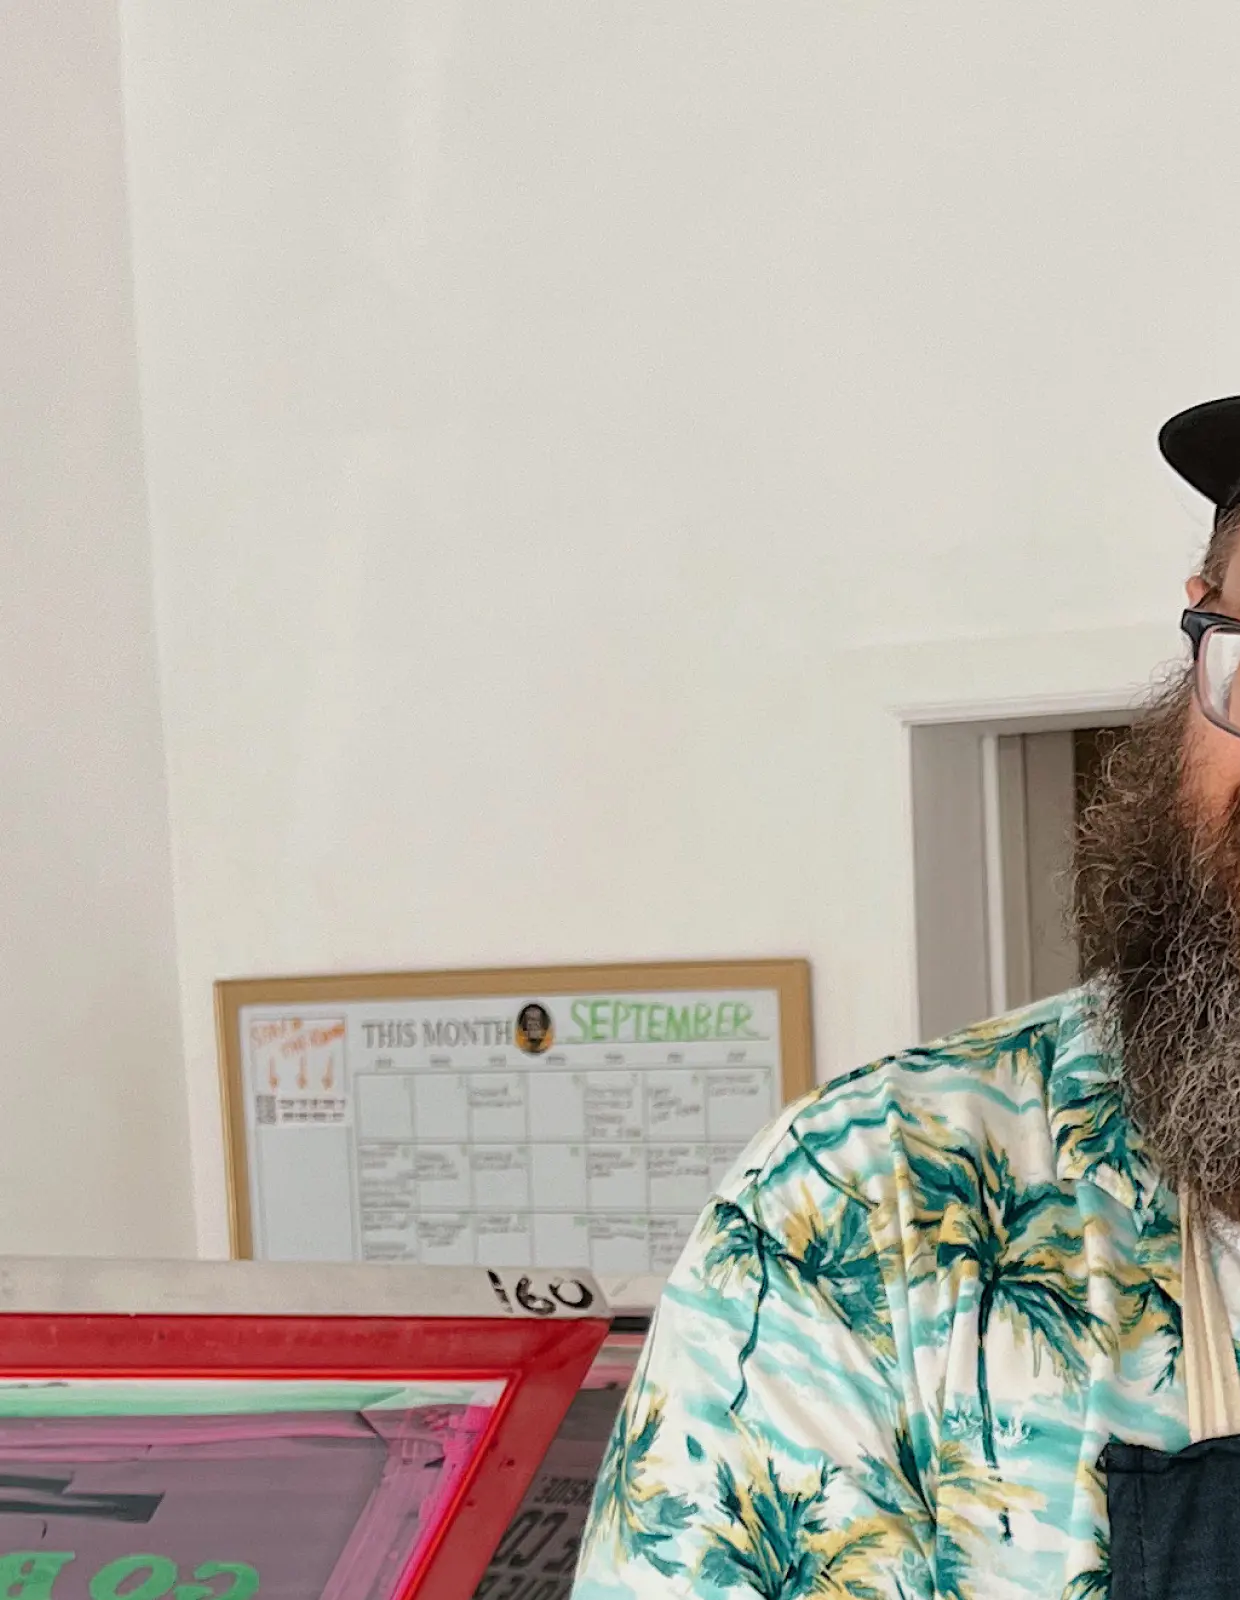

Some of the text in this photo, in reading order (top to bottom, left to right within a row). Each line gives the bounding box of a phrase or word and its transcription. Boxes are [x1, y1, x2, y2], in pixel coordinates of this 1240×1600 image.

[361, 1020, 417, 1049] THIS
[422, 1017, 512, 1048] MONTH
[570, 1000, 757, 1042] SEPTEMBER
[486, 1268, 593, 1315] 160
